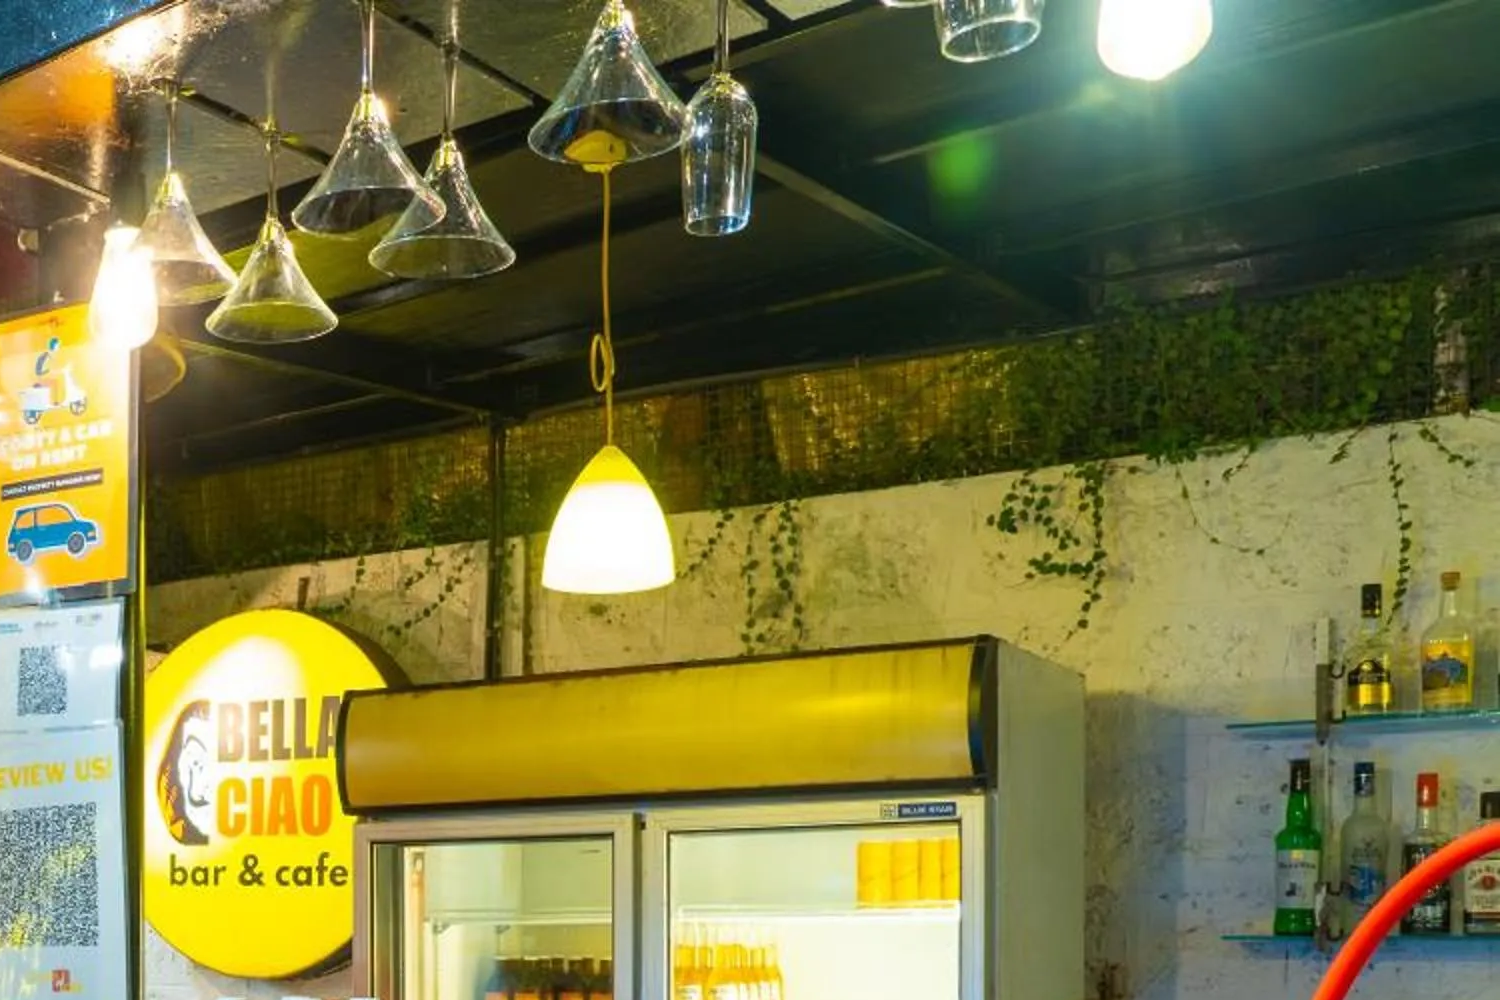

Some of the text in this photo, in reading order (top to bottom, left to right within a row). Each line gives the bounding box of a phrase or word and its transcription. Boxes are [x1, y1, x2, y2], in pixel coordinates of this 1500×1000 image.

[217, 695, 341, 763] BELLA
[217, 773, 333, 838] CIAO
[169, 852, 349, 887] bar & cafe
